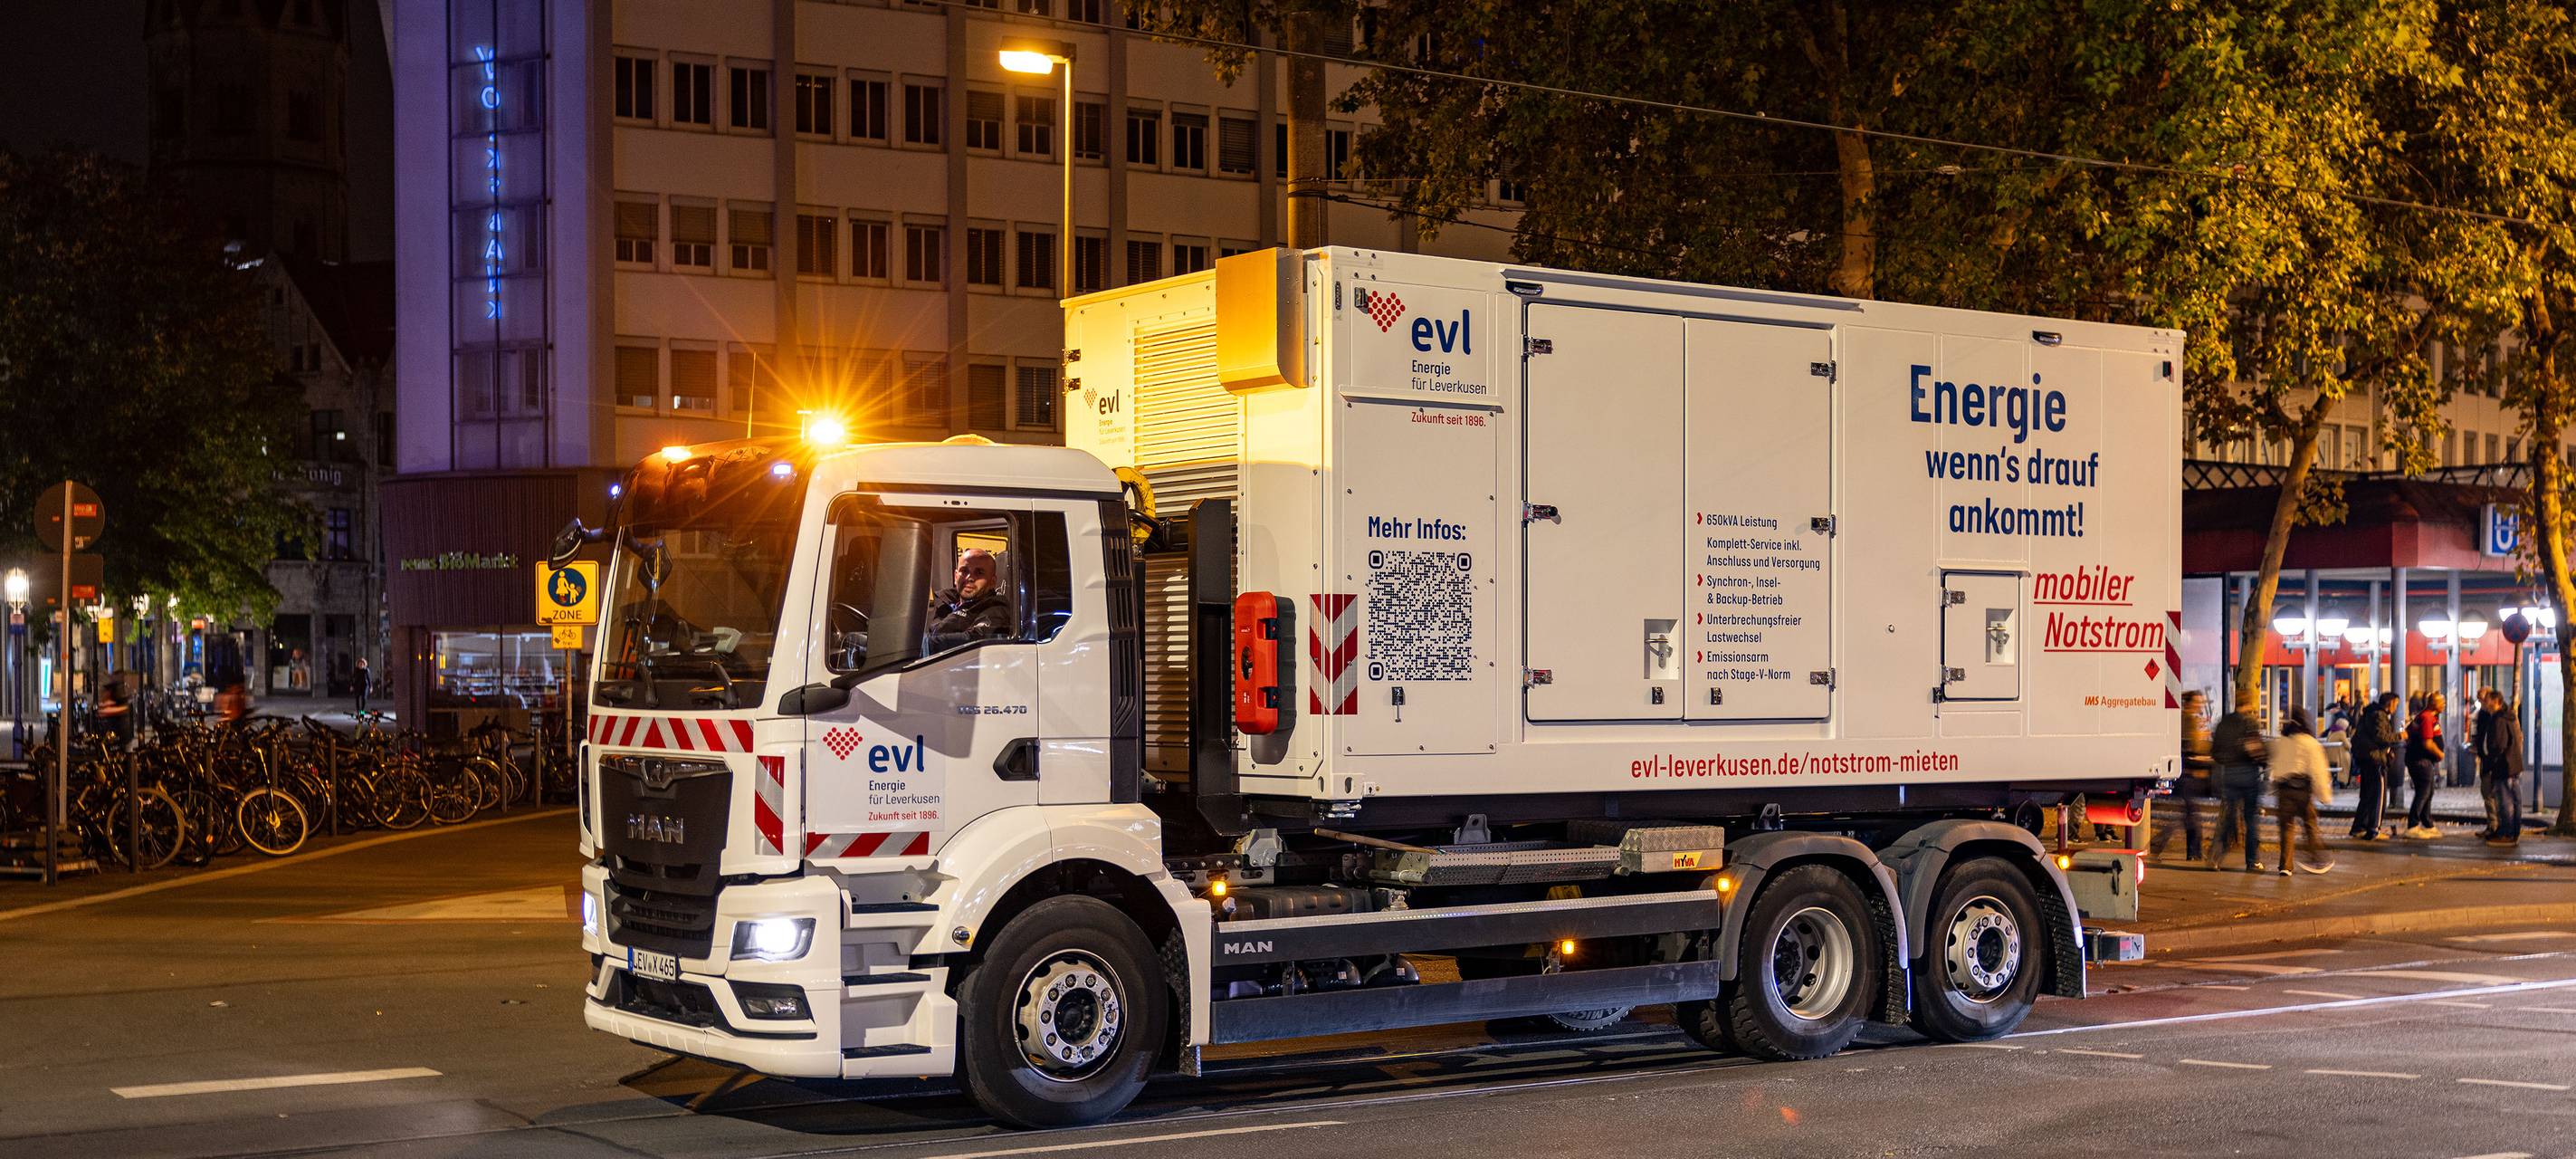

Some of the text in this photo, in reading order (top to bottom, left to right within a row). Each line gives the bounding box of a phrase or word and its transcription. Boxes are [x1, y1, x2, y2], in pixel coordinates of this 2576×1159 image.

[1411, 309, 1471, 355] evl
[1412, 359, 1451, 377] Energie
[1412, 377, 1487, 395] für Leverkusen
[1099, 389, 1120, 415] evl
[1911, 364, 2066, 444] Energie
[1412, 412, 1486, 426] Zukunft seit 1896.
[2027, 448, 2099, 487] drauf
[1706, 513, 1778, 531] 650kVA Leistung
[1949, 497, 2084, 537] ankommt!
[1368, 516, 1466, 541] Mehr Infos:
[2495, 510, 2514, 551] U
[1707, 537, 1802, 551] Komplett-Service inkl.
[1707, 554, 1820, 571] Anschluss und Versorgung
[1707, 575, 1780, 589] Synchron-, Insel-
[2034, 565, 2134, 601] mobiler
[1707, 592, 1783, 607] & Backup-Betrieb
[553, 610, 582, 619] ZONE
[1707, 613, 1801, 628] Unterbrechungsfreier
[1707, 631, 1761, 643] Lastwechsel
[2044, 612, 2164, 648] Notstrom
[1707, 651, 1769, 663] Emissionsarm
[1707, 669, 1791, 683] nach Stage-V-Norm
[984, 705, 1027, 714] 26.470
[2085, 696, 2156, 708] IMS Aggregatebau
[868, 734, 925, 773] evl
[1630, 750, 1959, 778] evl-leverkusen.de/notstrom-mieten
[869, 780, 906, 792] Energie
[869, 793, 940, 805] für Leverkusen
[868, 809, 940, 821] Zukunft seit 1896.
[627, 813, 683, 845] MAN
[1674, 855, 1694, 867] HYVA
[1224, 941, 1273, 954] MAN
[633, 951, 674, 976] LEV X 465
